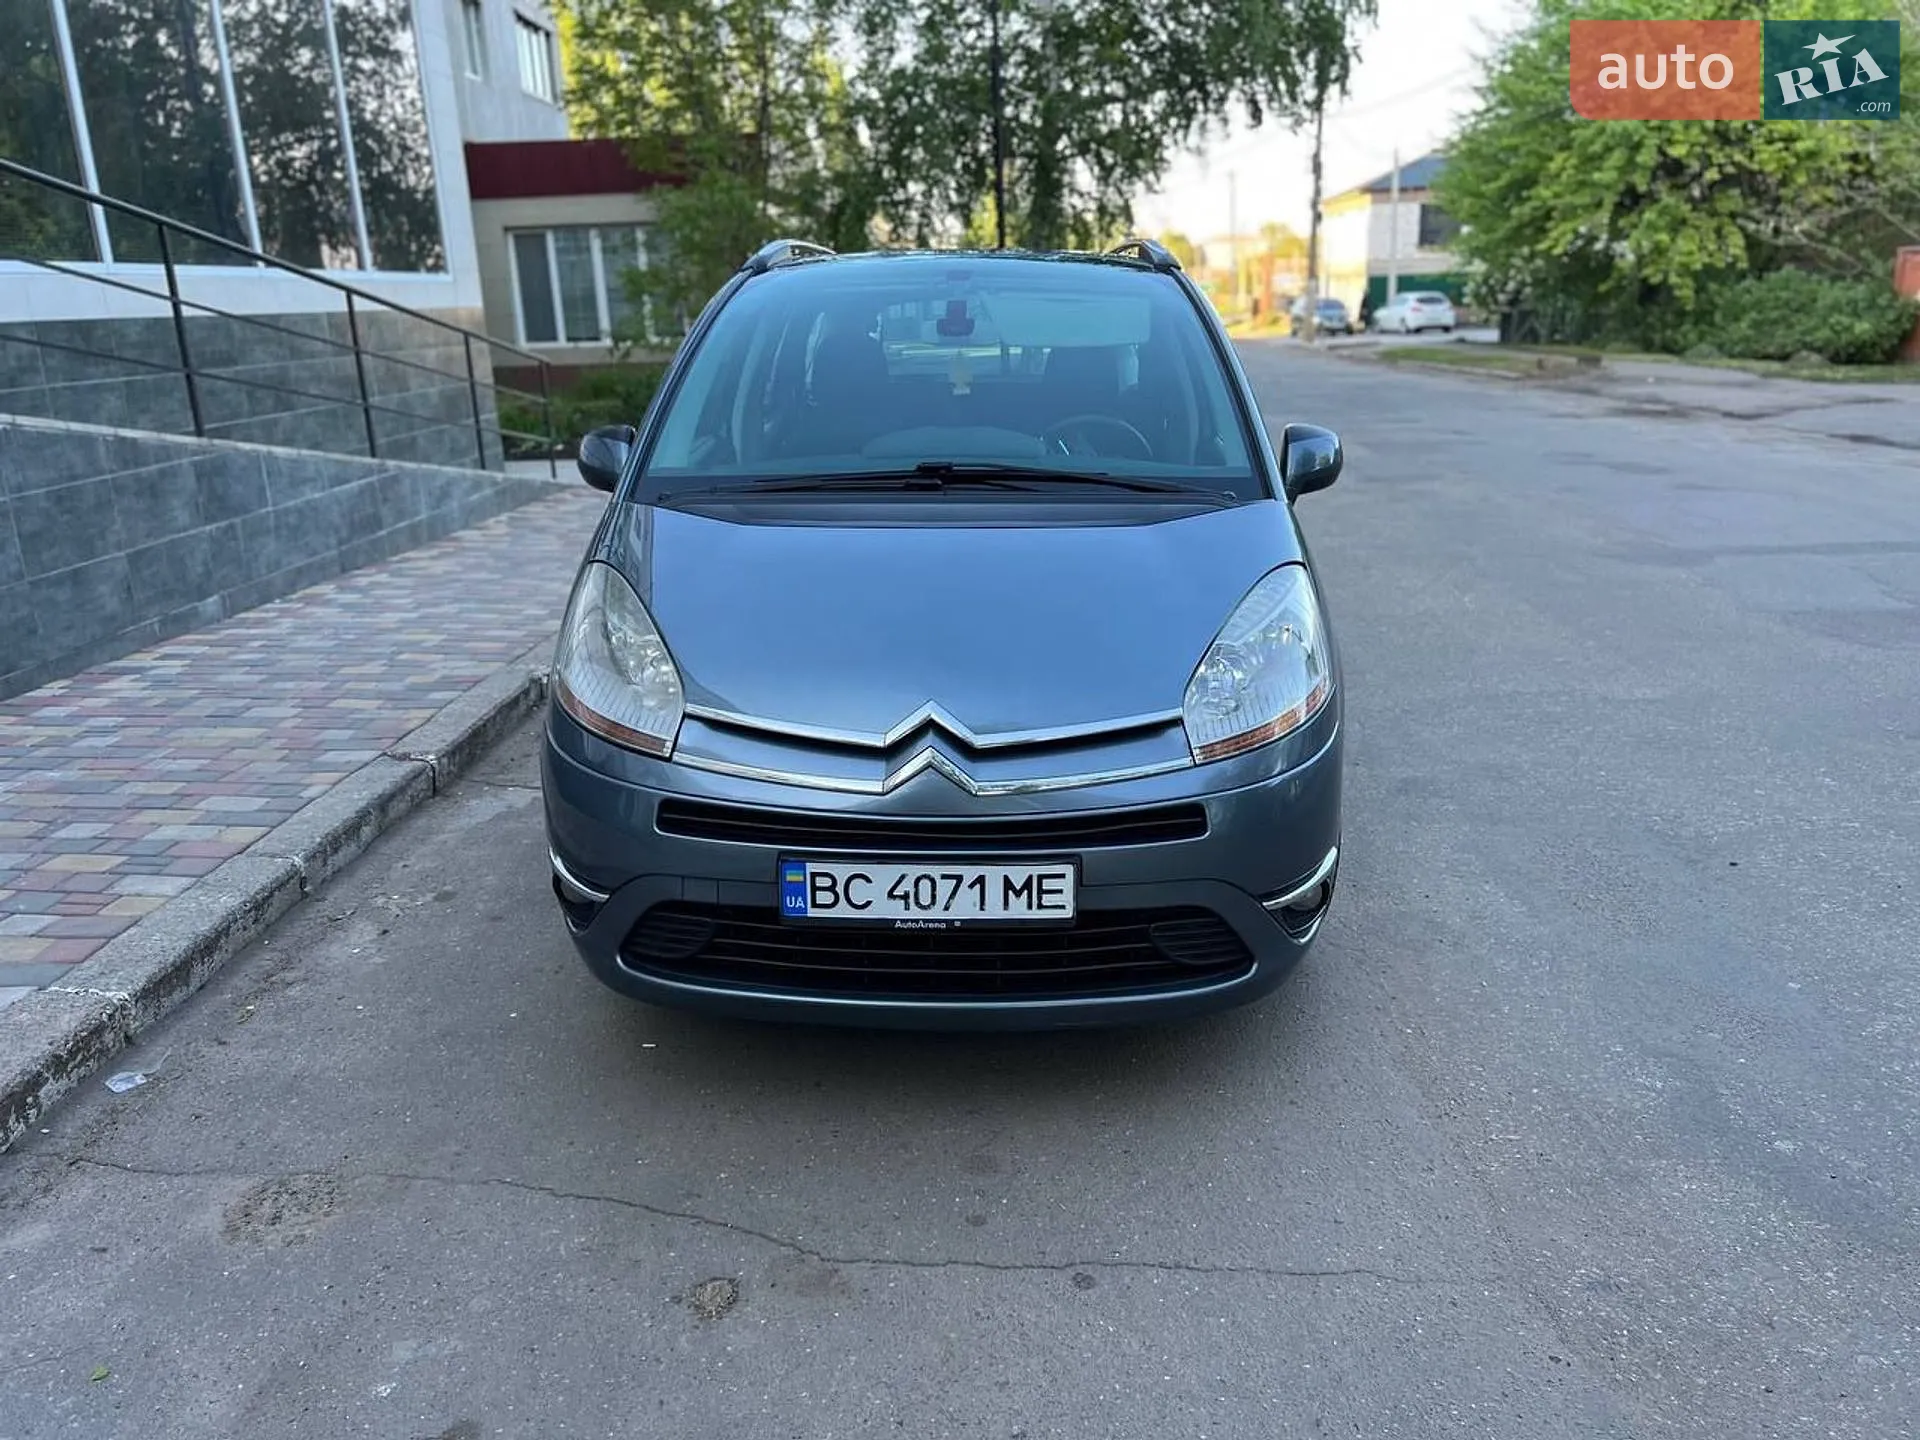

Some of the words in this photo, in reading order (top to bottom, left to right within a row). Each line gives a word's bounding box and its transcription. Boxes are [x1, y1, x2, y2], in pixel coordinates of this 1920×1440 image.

[809, 871, 874, 910] BC
[886, 872, 986, 912] 4071
[1003, 872, 1067, 911] ME
[786, 896, 805, 909] UA
[894, 919, 947, 929] AutoArena
